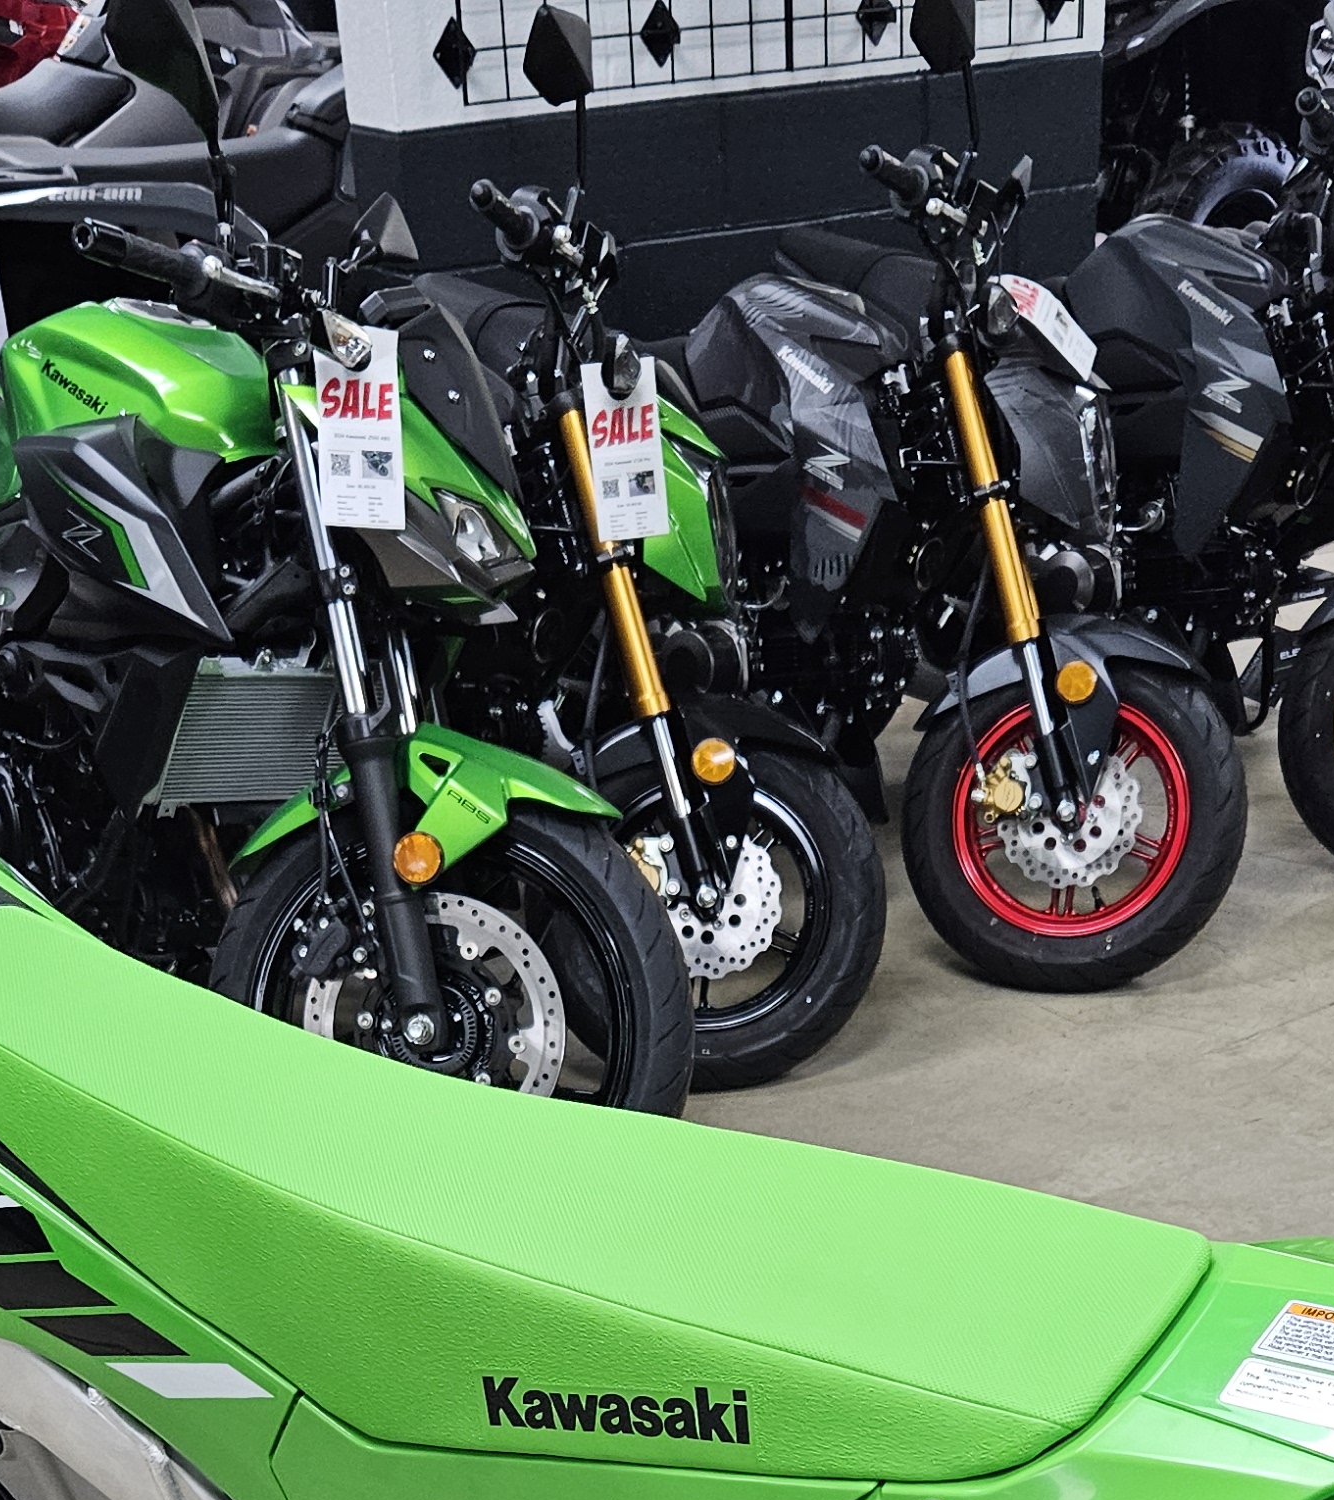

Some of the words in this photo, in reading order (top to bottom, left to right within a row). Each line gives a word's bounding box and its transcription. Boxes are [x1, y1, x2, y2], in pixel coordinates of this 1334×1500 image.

[1177, 279, 1235, 326] Kawasaki
[42, 359, 109, 415] Kawasaki
[777, 345, 835, 394] Kawasaki
[321, 377, 393, 421] SALE
[592, 404, 654, 448] SALE
[447, 790, 491, 824] ABS
[482, 1376, 751, 1444] Kawasaki
